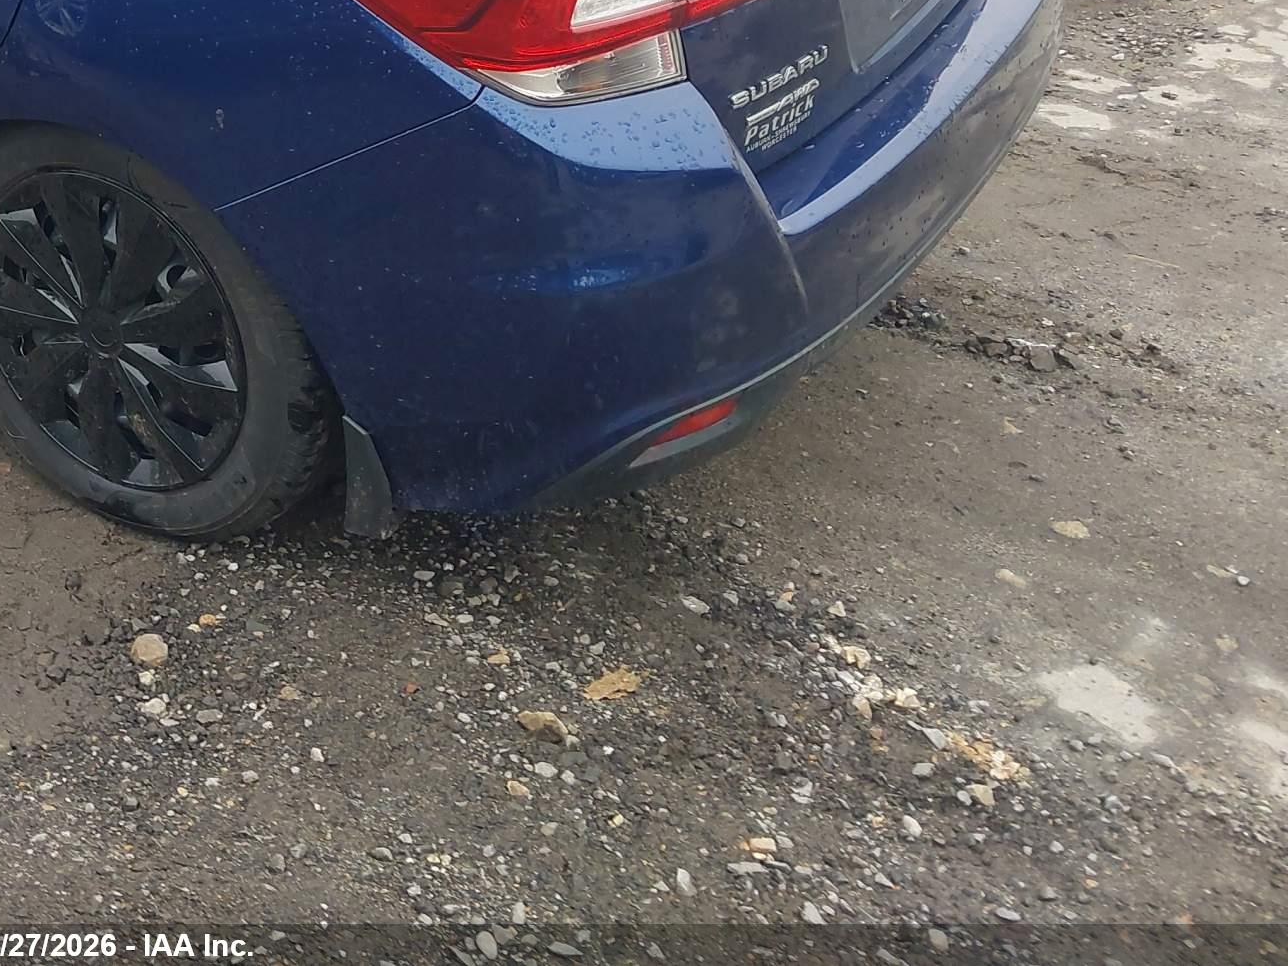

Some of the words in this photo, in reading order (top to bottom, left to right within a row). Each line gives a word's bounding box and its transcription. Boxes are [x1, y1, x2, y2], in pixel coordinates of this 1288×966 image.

[730, 45, 829, 109] SUBARU
[744, 94, 815, 146] Patrick
[761, 126, 797, 151] WORCESTER
